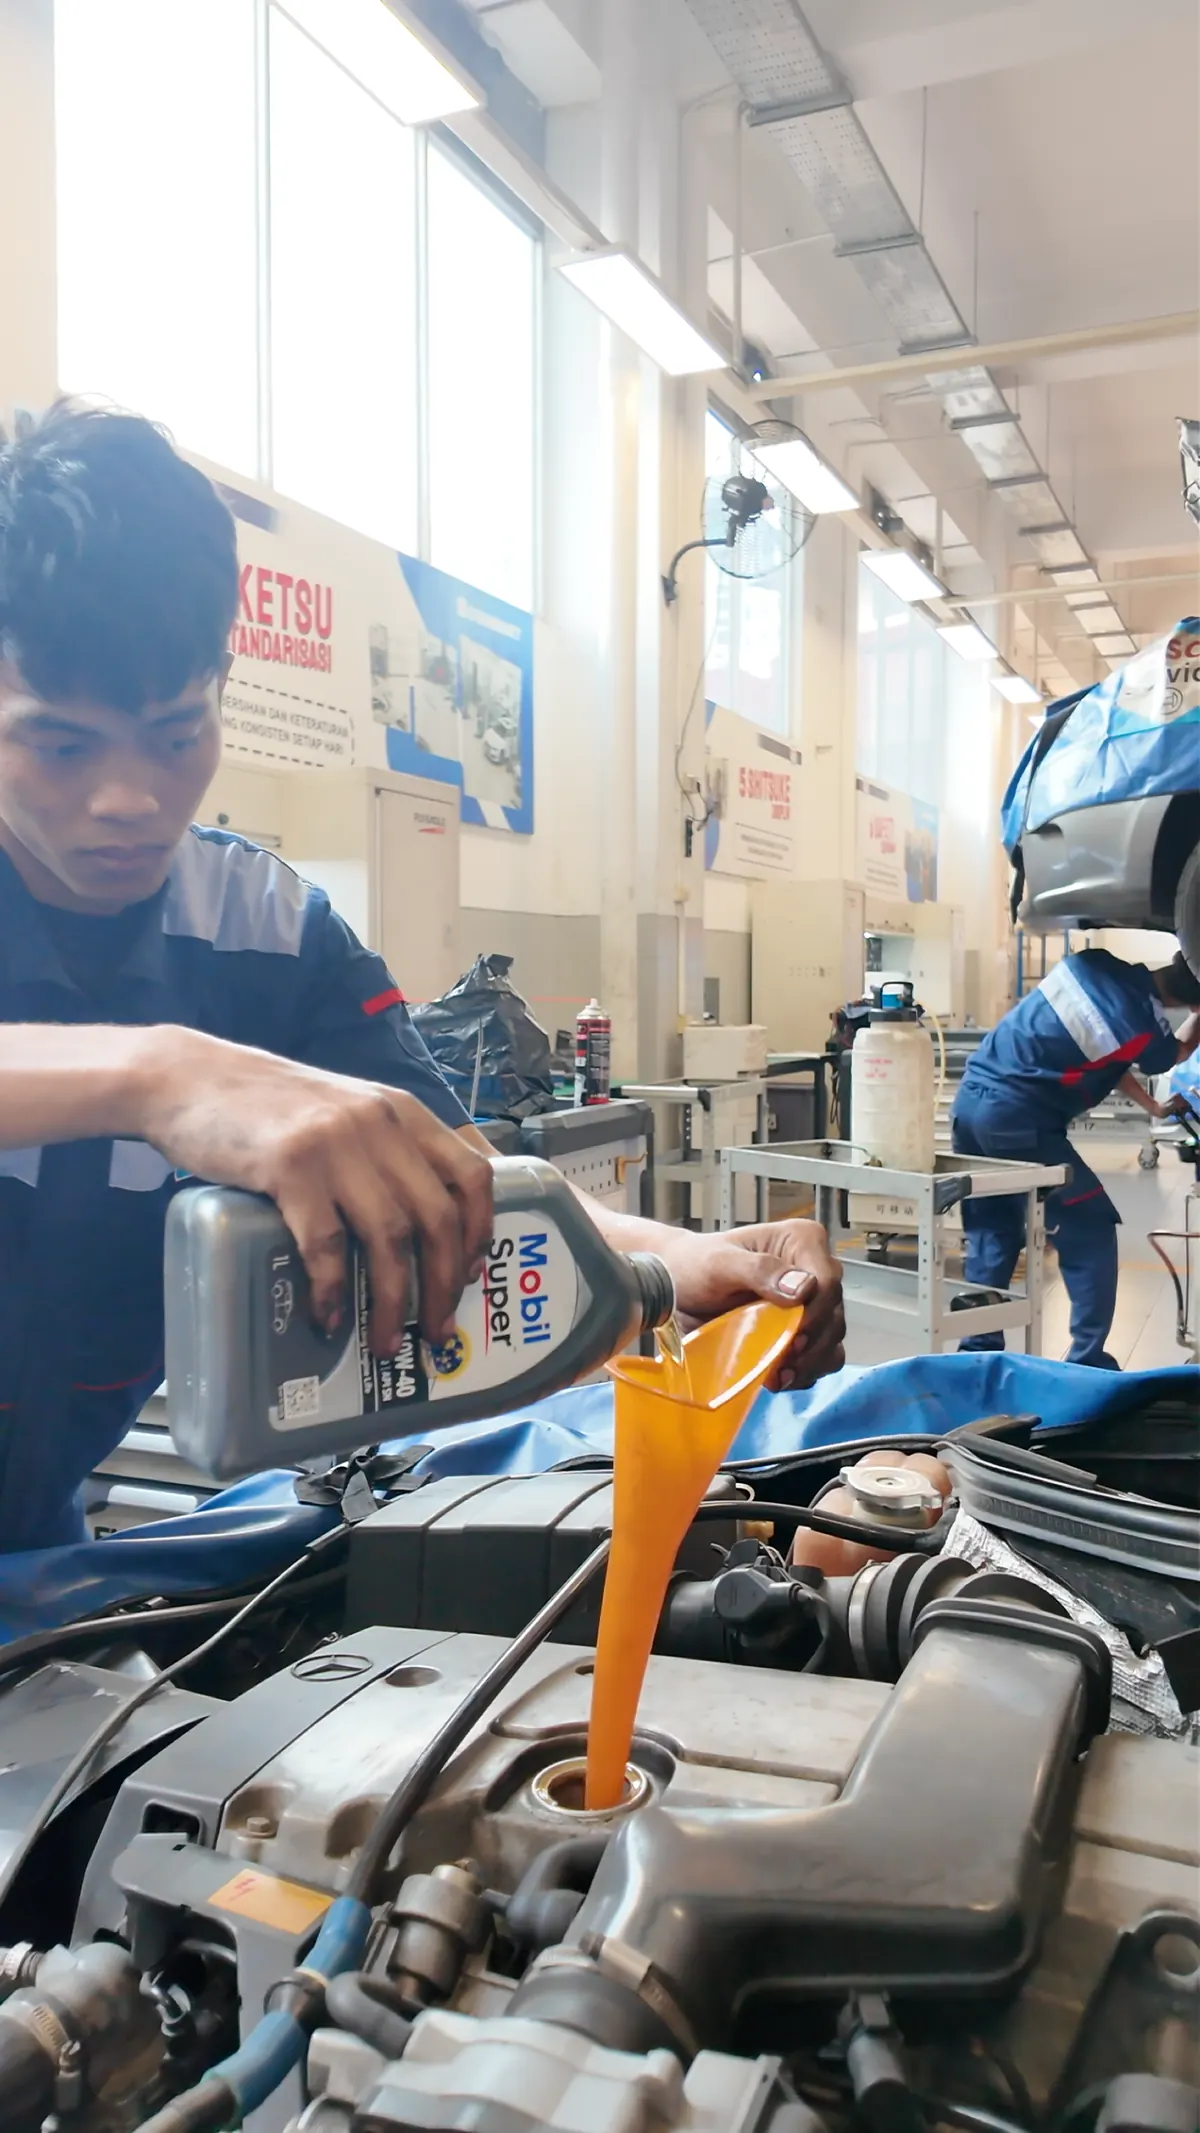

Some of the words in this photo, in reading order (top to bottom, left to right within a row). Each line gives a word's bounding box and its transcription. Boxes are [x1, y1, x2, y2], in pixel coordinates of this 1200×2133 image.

[239, 564, 332, 640] KETSU
[482, 1238, 512, 1346] Super
[519, 1233, 551, 1345] Mobil
